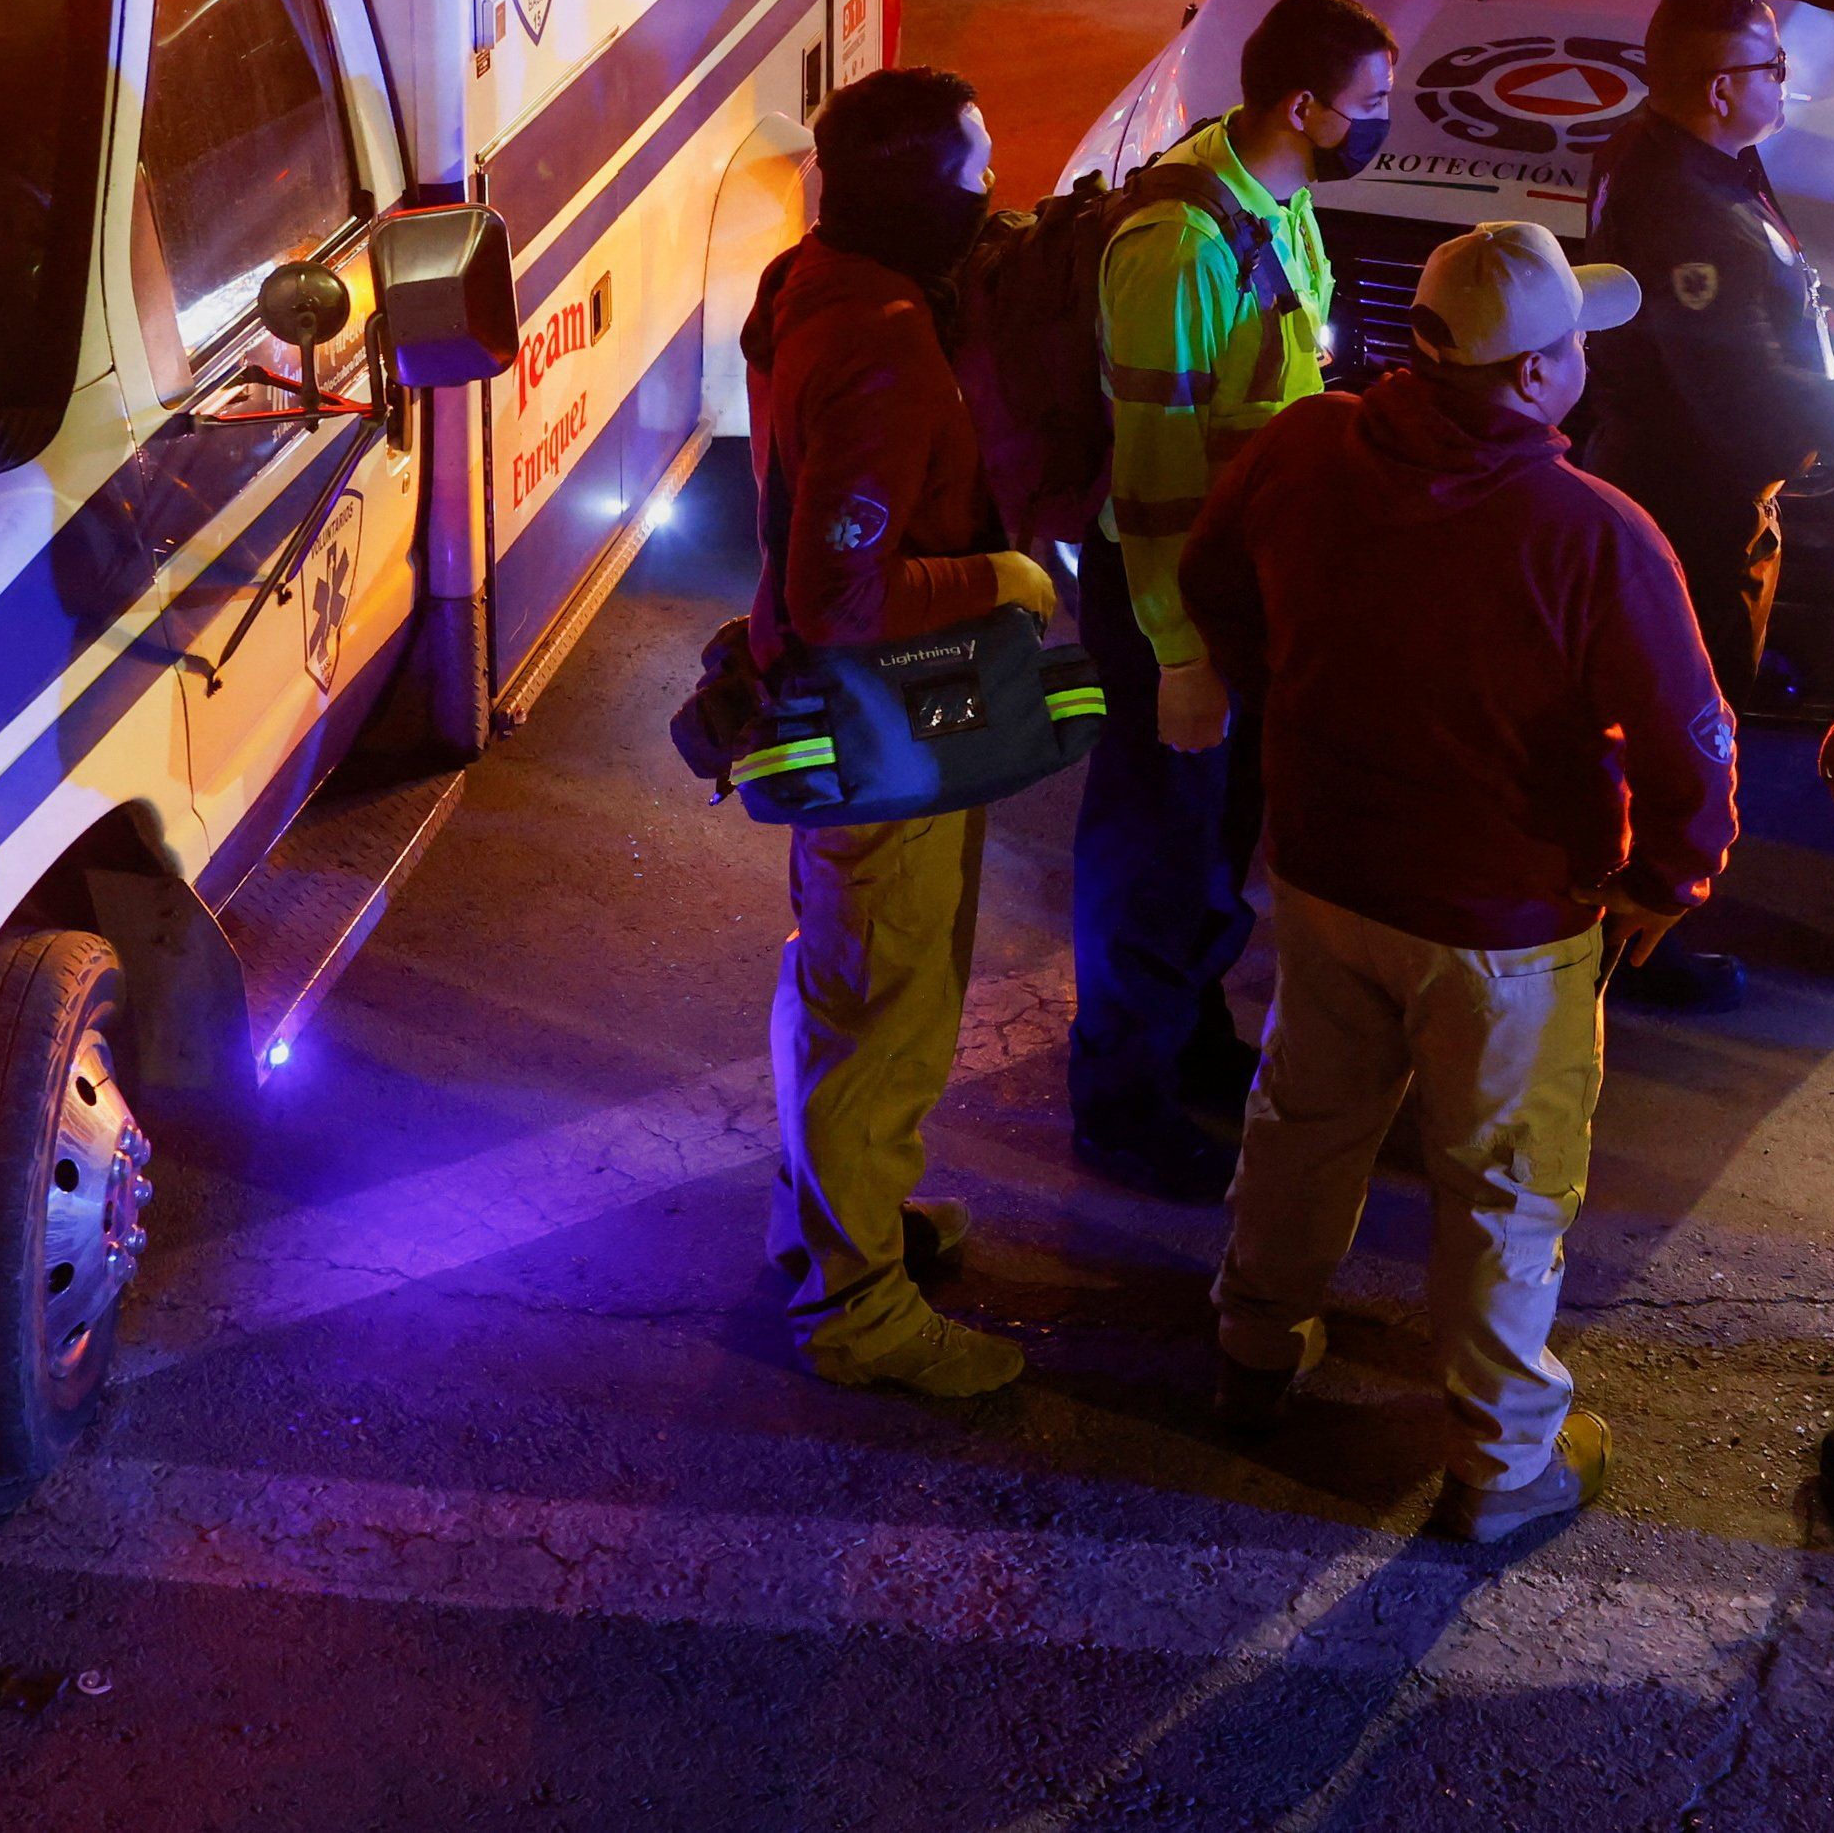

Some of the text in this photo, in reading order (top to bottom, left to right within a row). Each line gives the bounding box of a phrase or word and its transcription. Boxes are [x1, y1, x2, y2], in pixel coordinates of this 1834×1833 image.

[1374, 152, 1579, 188] ROTECCIÓN
[513, 300, 586, 421] Team
[513, 390, 587, 510] Enriquez
[880, 646, 961, 667] Lightning
